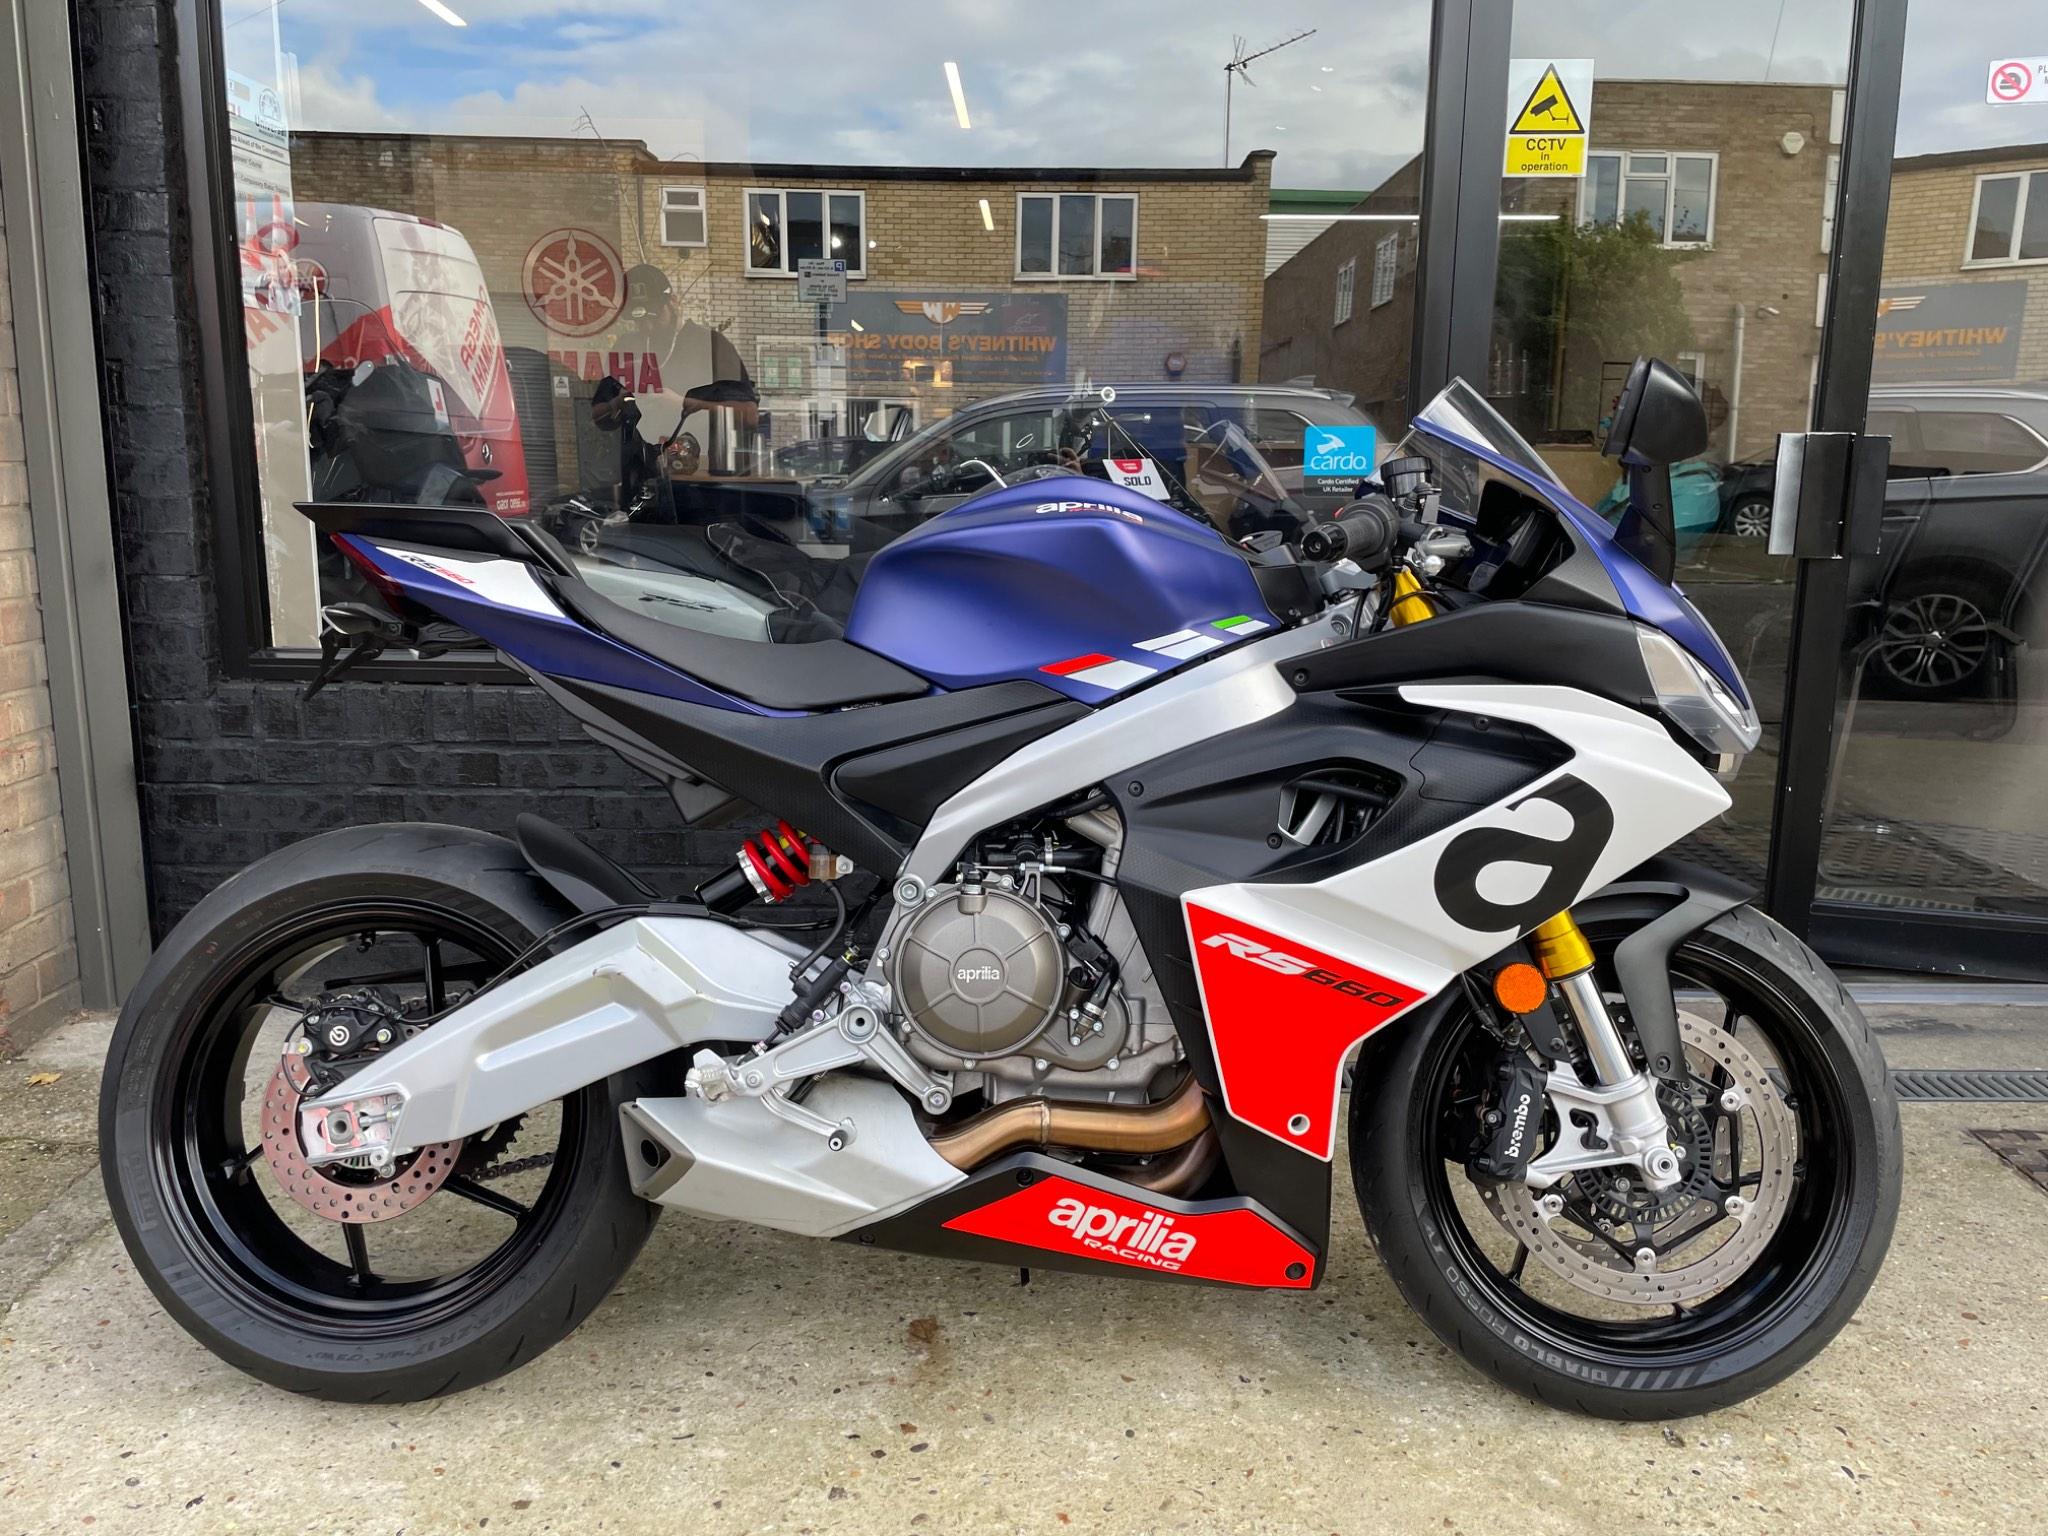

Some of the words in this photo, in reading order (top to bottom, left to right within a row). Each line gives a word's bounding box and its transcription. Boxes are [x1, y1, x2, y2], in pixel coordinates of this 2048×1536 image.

[1526, 138, 1567, 151] CCTV
[1540, 152, 1550, 161] in
[1520, 162, 1568, 173] operation
[1310, 451, 1366, 471] cardo
[1123, 476, 1152, 487] SOLD
[957, 965, 1000, 984] aprilia
[1504, 1094, 1531, 1158] brembo
[1048, 1197, 1197, 1262] aprilia
[1083, 1237, 1182, 1271] RACING
[1446, 1266, 1509, 1337] ROSSO
[1513, 1335, 1609, 1386] DIABLO
